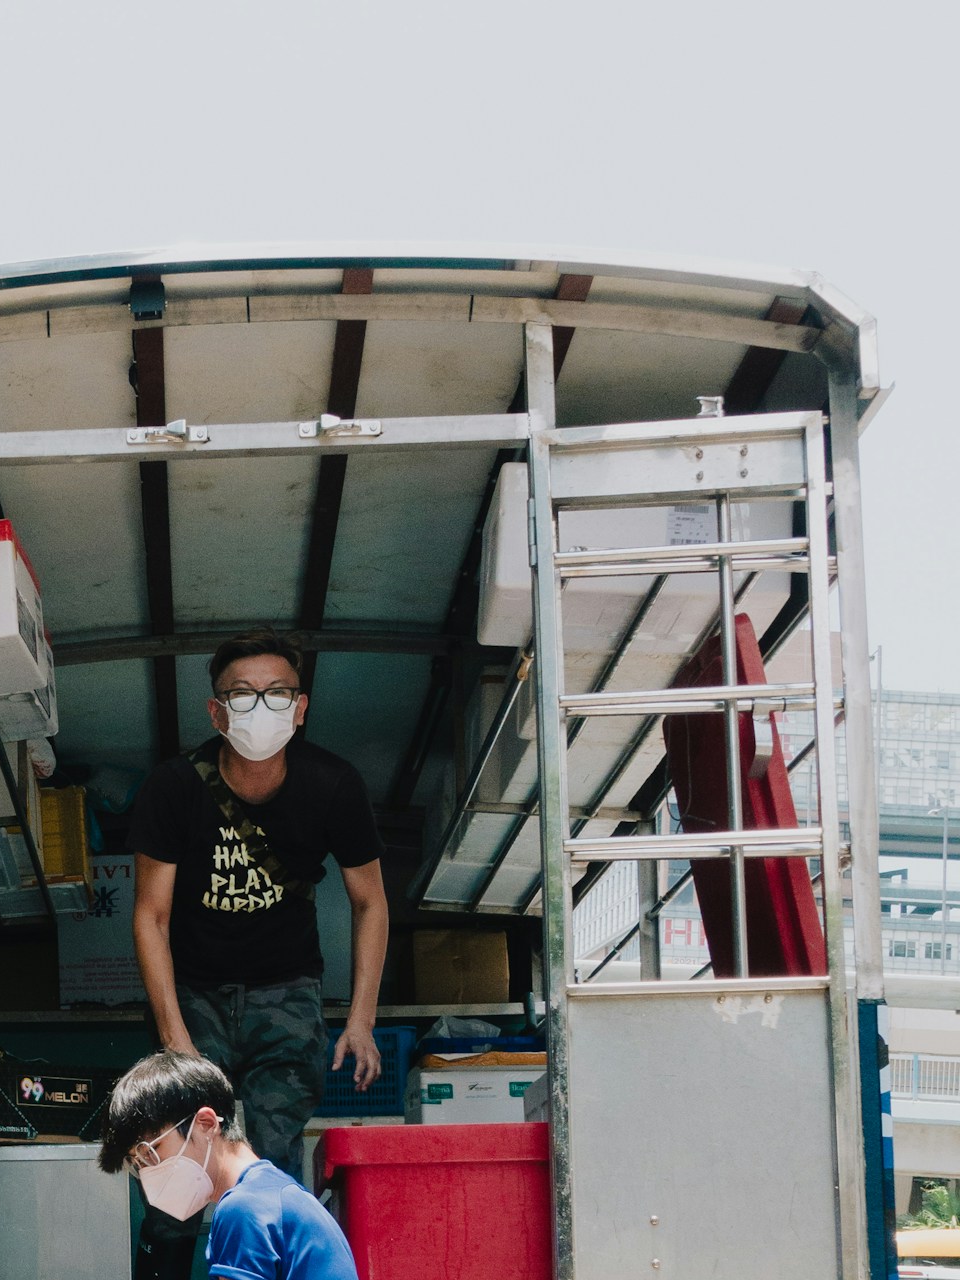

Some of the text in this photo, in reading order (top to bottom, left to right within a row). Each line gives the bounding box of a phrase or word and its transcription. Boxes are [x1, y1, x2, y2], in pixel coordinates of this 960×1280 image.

[213, 843, 256, 870] HAR
[20, 1077, 88, 1103] 99 MELON
